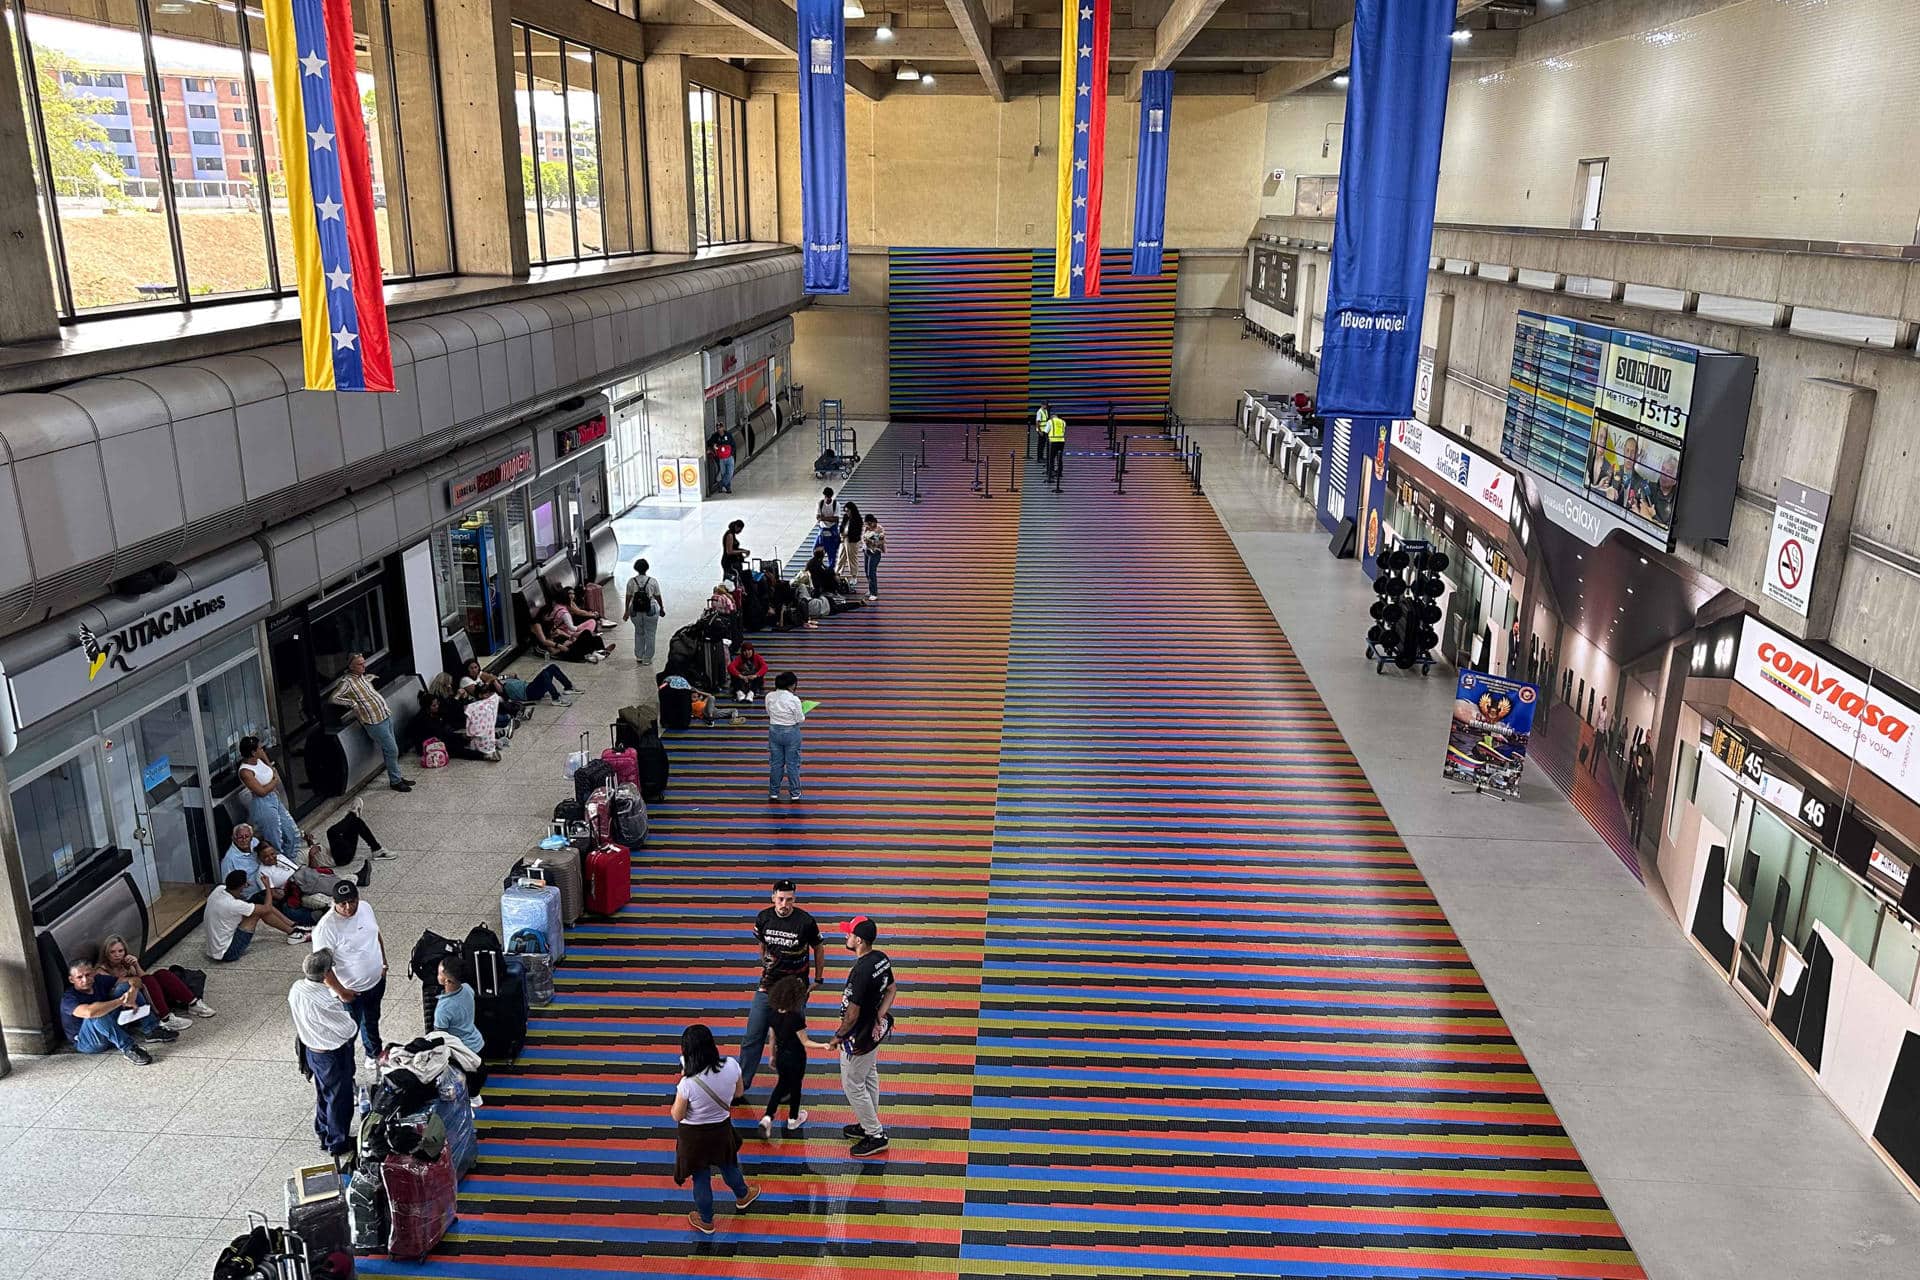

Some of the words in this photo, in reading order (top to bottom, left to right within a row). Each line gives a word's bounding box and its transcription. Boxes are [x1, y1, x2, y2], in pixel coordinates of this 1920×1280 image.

[1340, 311, 1372, 329] ¡Buen
[1375, 314, 1406, 332] viaje!
[1616, 356, 1672, 393] SINIV
[1626, 396, 1638, 408] Sep
[1640, 397, 1682, 428] 15:13
[1445, 443, 1460, 464] Copa
[1437, 457, 1458, 481] Airlines
[1483, 488, 1504, 510] IBERIA
[1564, 497, 1600, 540] Galaxy
[1814, 703, 1822, 715] El
[1822, 708, 1852, 733] placer
[1853, 729, 1868, 744] de
[1869, 738, 1893, 759] volar
[1744, 752, 1763, 779] 45
[1803, 798, 1825, 828] 46
